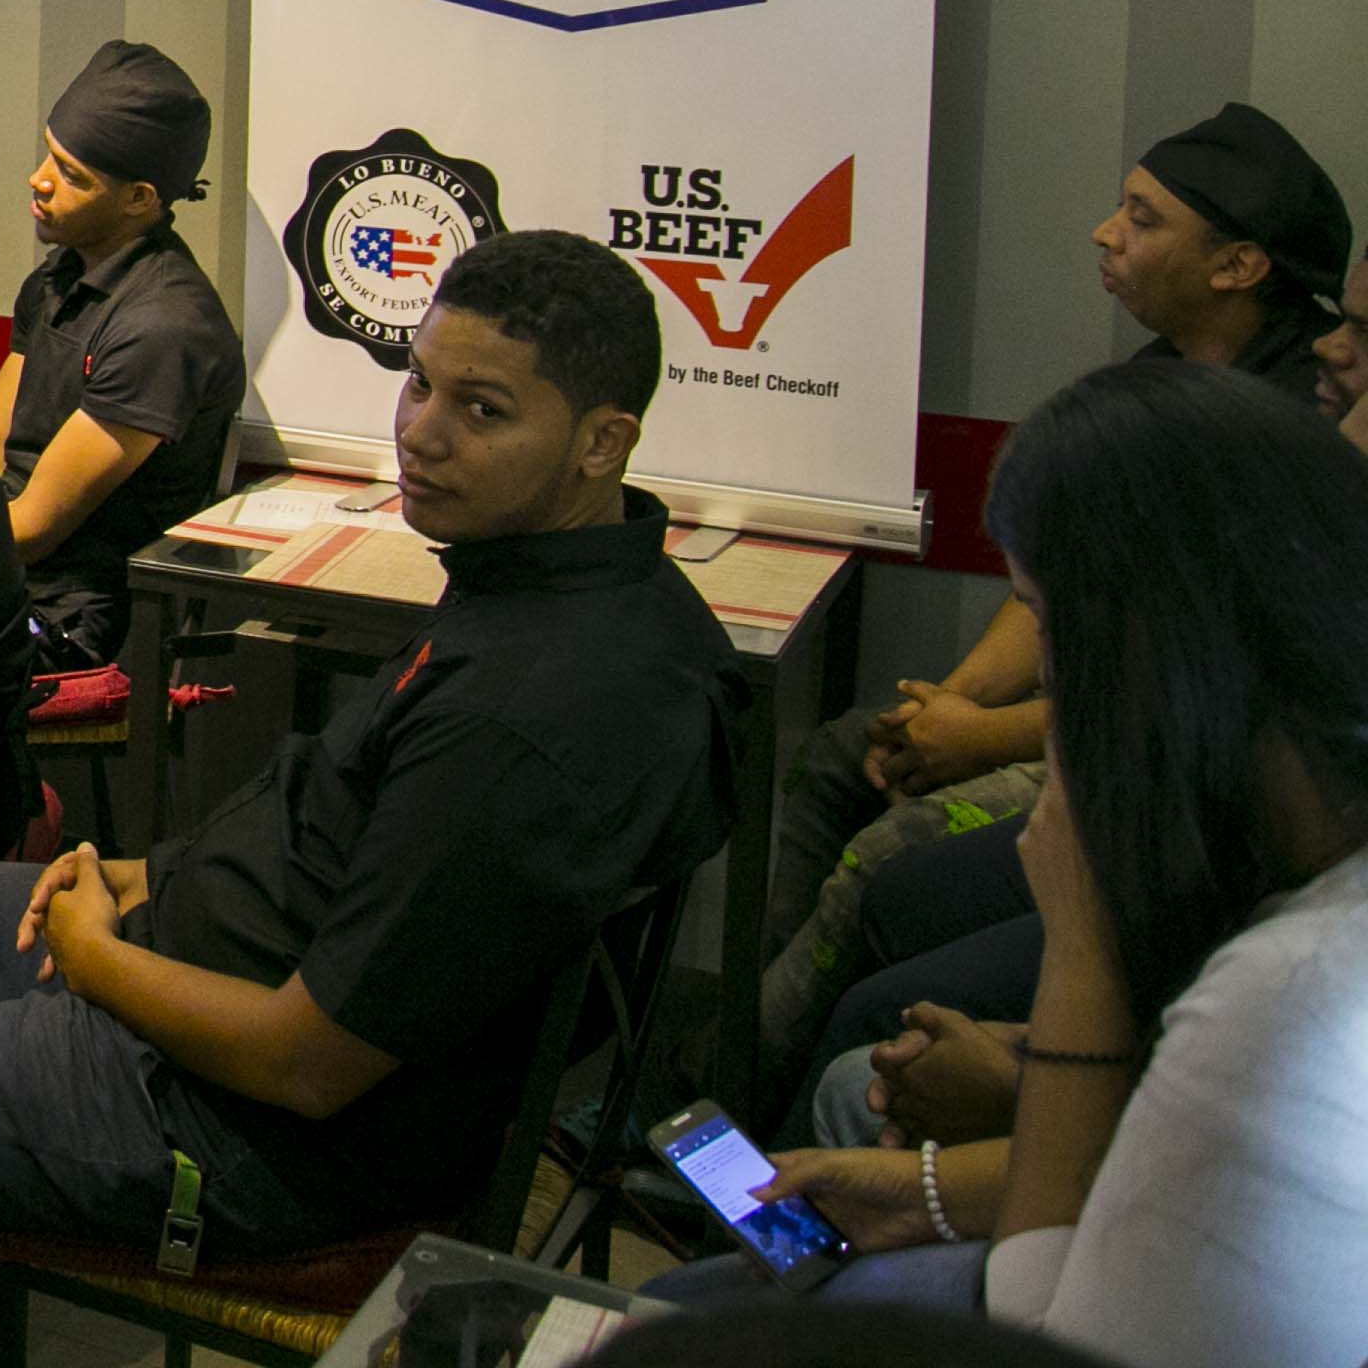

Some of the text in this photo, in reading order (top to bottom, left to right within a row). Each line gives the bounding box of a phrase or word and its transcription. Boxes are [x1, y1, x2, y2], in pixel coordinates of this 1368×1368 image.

[338, 158, 465, 199] LO BUENO
[641, 164, 729, 211] U.S.
[348, 189, 455, 227] U.S. MEAT
[608, 208, 762, 260] BEEF
[319, 282, 345, 312] SE
[333, 258, 431, 311] EXPORT FEDER
[667, 363, 840, 398] by the Beef Checkoff
